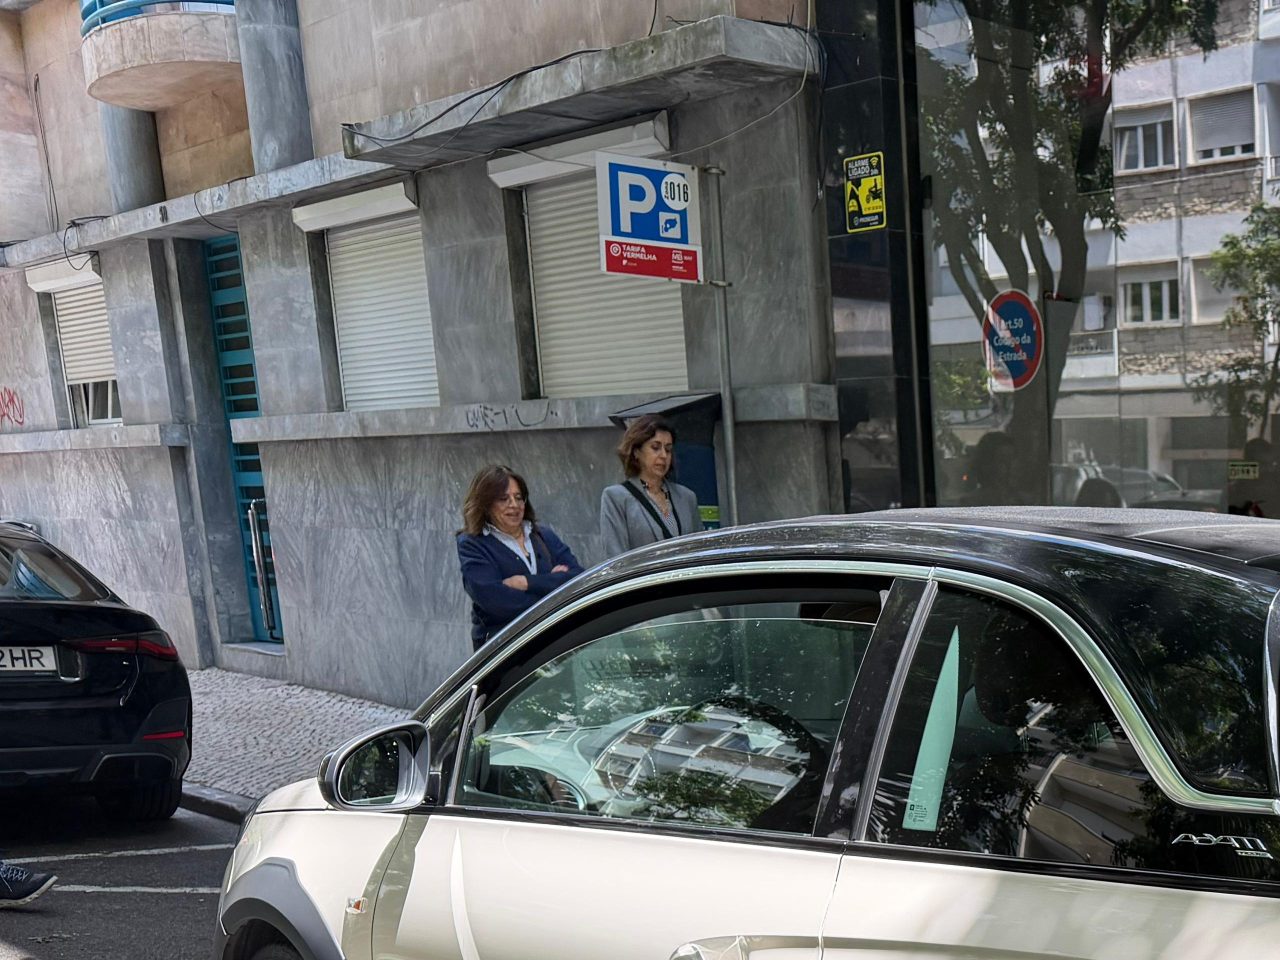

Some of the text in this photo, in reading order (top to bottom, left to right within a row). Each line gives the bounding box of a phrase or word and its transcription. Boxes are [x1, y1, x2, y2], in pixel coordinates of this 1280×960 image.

[848, 158, 869, 168] ALARME
[848, 165, 870, 177] LIGADO
[669, 181, 689, 203] 016
[617, 171, 657, 233] P
[622, 244, 646, 253] TARIFA
[622, 251, 657, 261] VERMELHA
[1021, 333, 1031, 344] da
[999, 348, 1028, 361] Estrada
